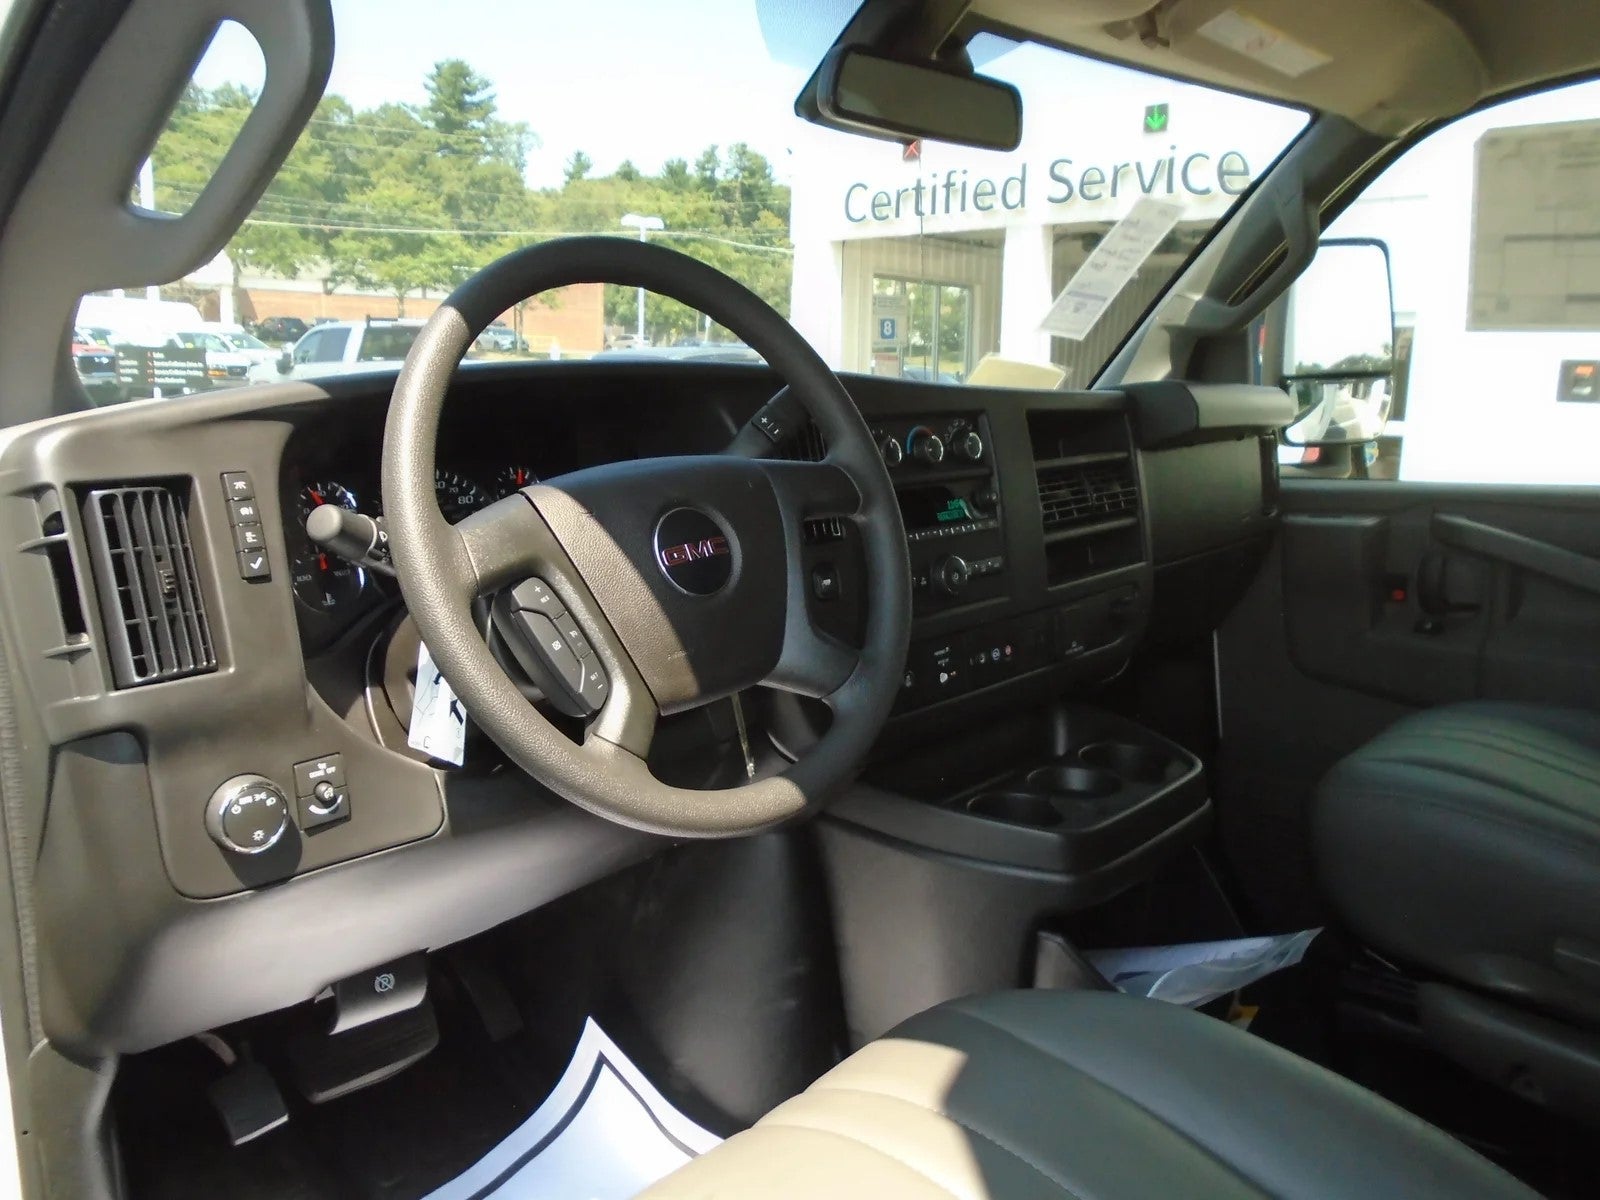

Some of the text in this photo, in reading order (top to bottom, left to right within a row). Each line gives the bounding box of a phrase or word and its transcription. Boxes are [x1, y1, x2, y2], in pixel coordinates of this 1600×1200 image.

[844, 144, 1250, 222] Certified Service
[883, 320, 893, 336] 8
[458, 495, 474, 505] 80
[661, 536, 729, 566] GMC
